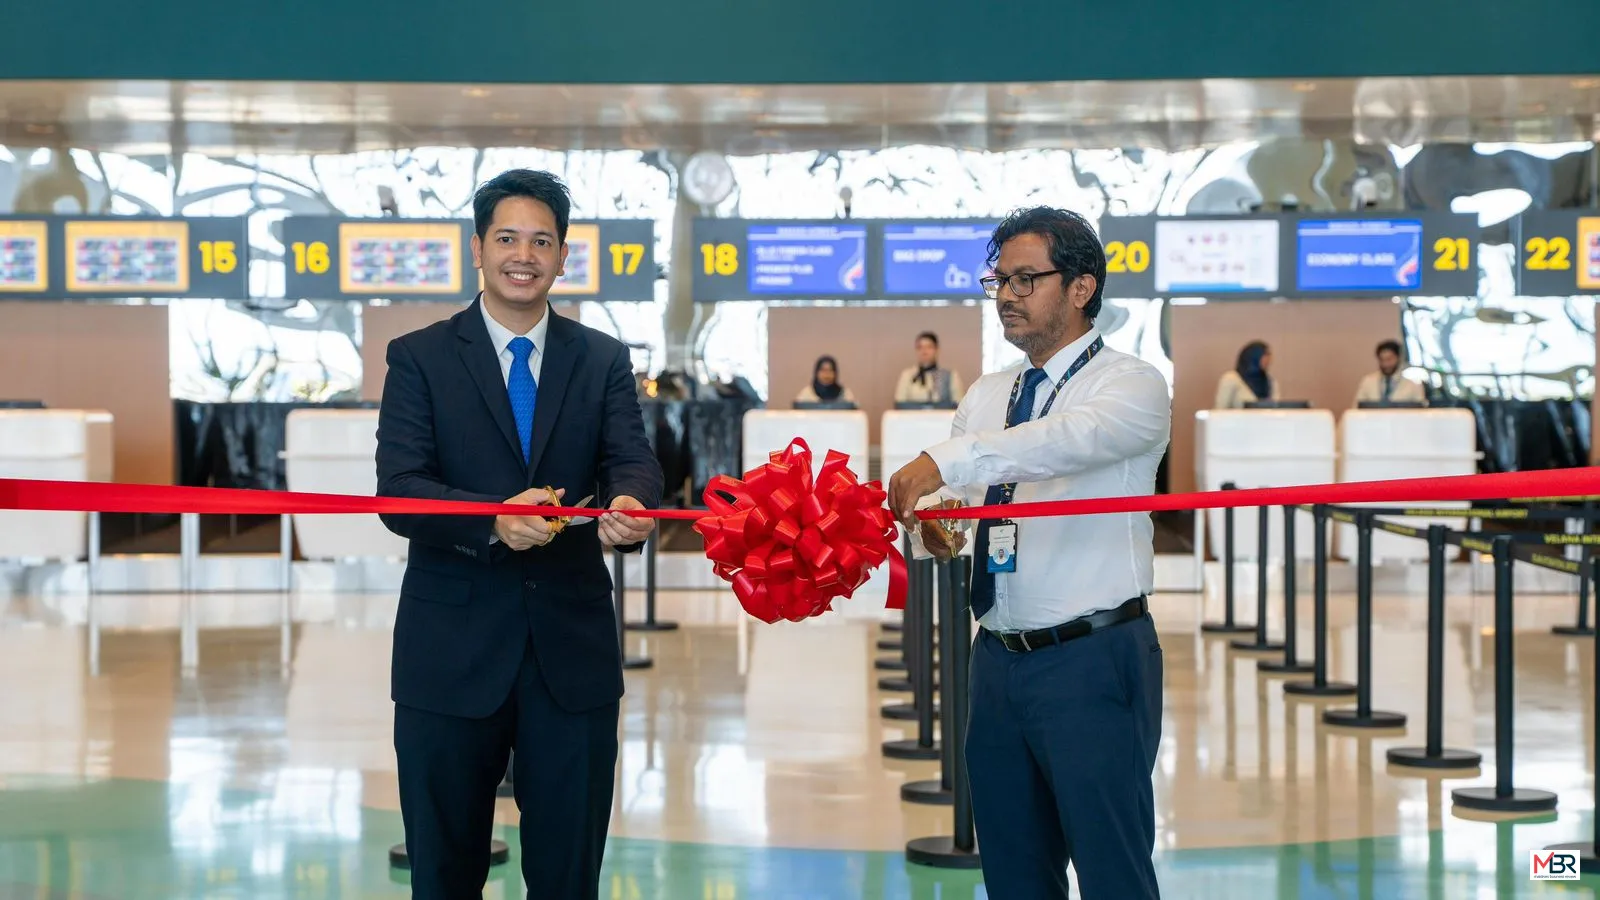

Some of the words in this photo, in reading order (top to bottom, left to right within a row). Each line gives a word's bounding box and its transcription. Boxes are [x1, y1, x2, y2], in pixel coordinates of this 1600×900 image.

[199, 241, 237, 273] 15
[292, 241, 330, 274] 16
[609, 243, 645, 275] 17
[701, 243, 738, 275] 18
[1104, 241, 1150, 273] 20
[1306, 252, 1359, 267] ECONOMY
[1361, 252, 1396, 267] CLASS
[1433, 237, 1470, 270] 21
[1525, 236, 1571, 270] 22
[1543, 533, 1580, 545] VELANA
